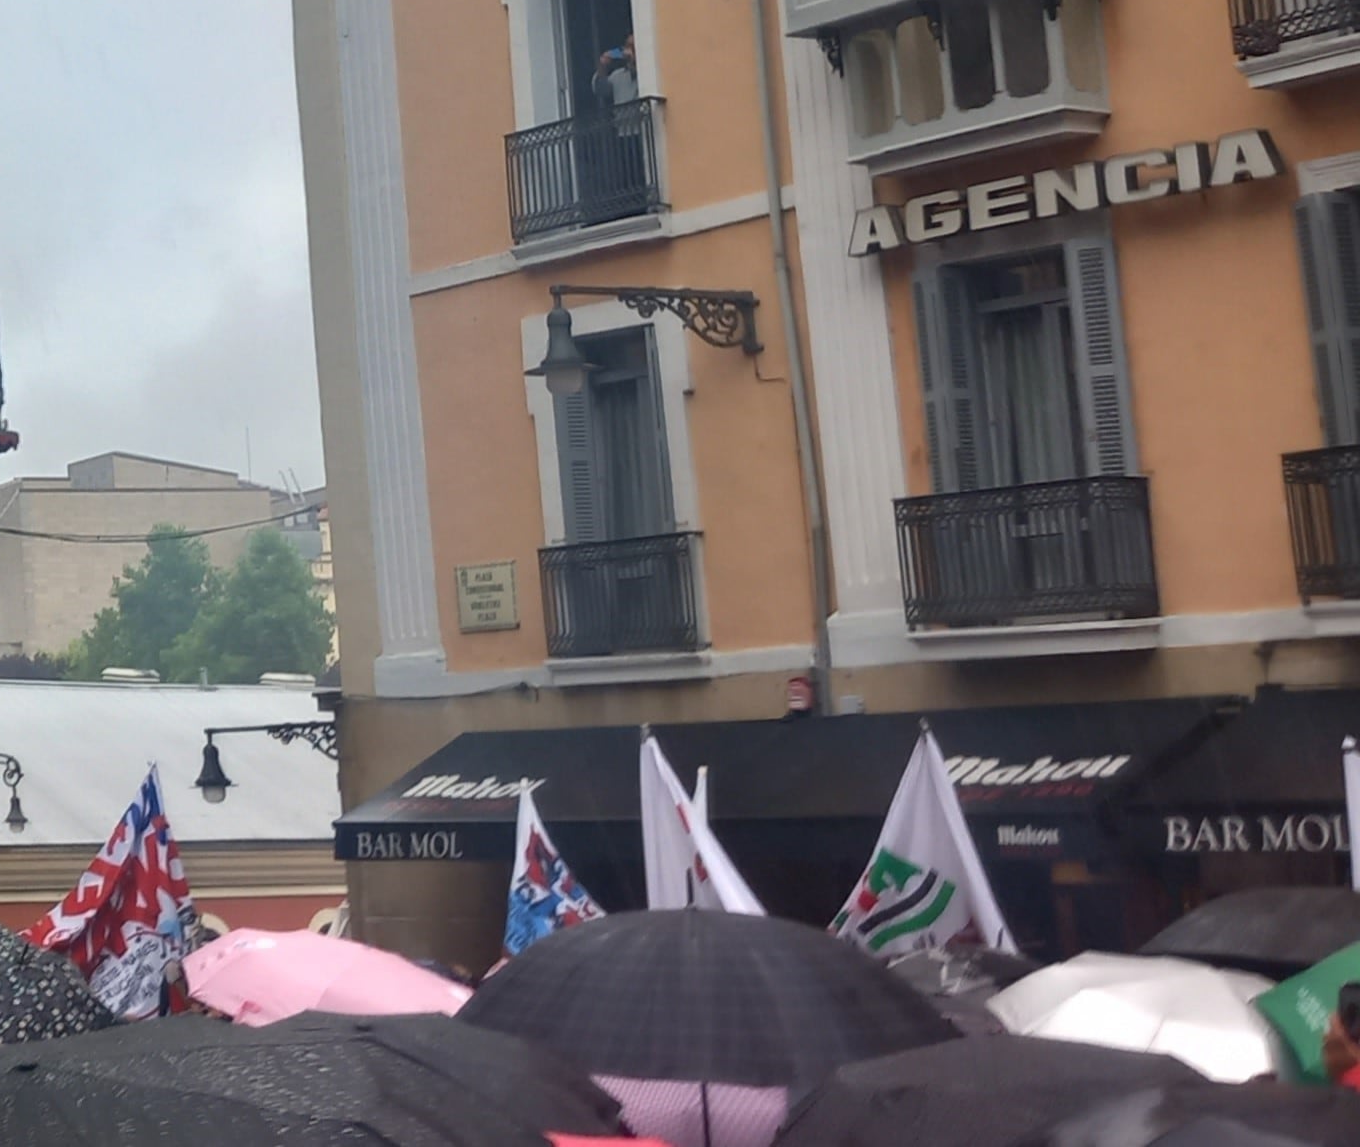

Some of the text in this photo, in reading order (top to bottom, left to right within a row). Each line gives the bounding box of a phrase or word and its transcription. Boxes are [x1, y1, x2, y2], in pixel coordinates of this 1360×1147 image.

[848, 128, 1282, 257] AGENCIA
[944, 754, 1130, 785] Mahou
[357, 831, 463, 859] BAR MOL
[997, 824, 1060, 846] Mahou
[1164, 814, 1351, 852] BAR MOL
